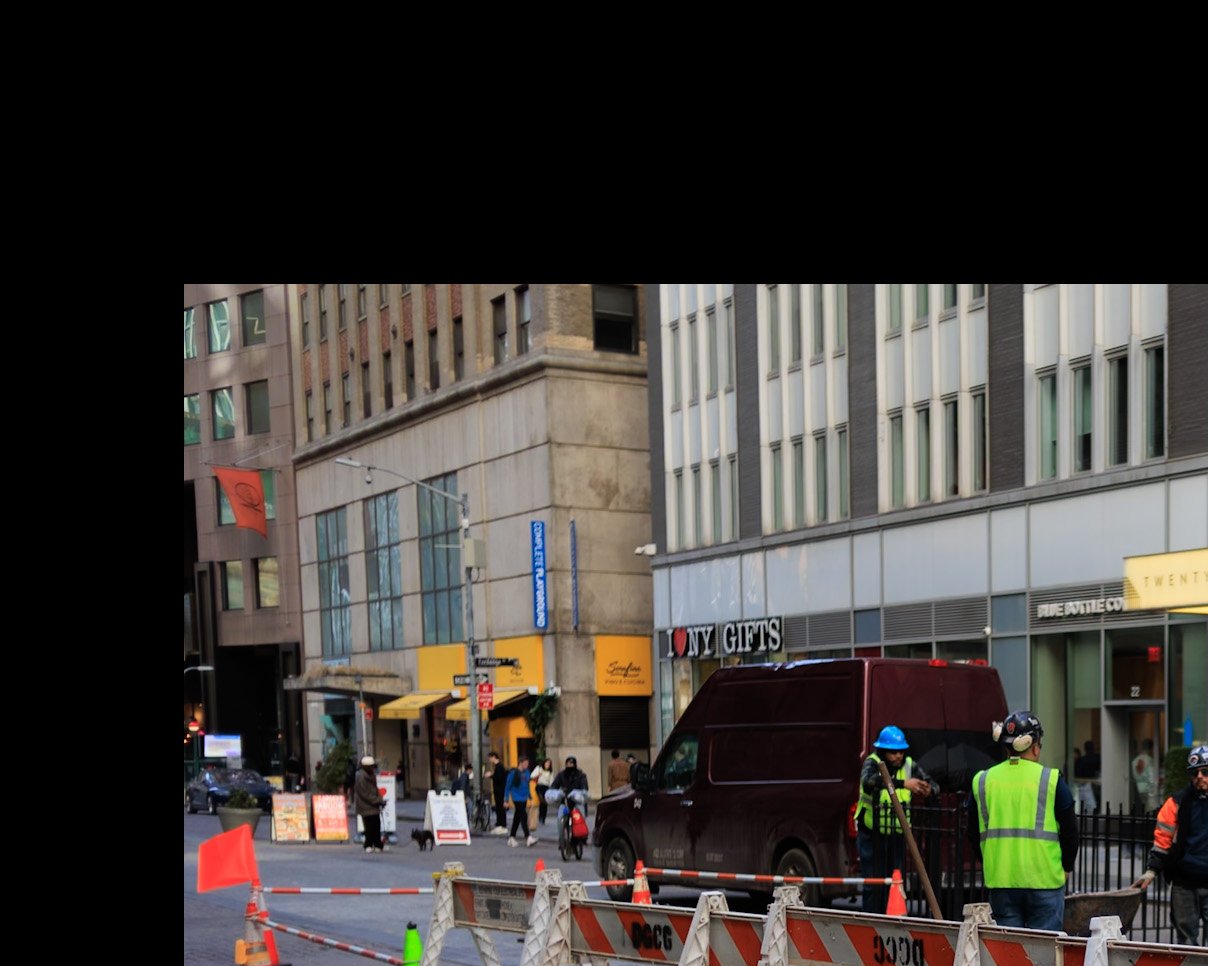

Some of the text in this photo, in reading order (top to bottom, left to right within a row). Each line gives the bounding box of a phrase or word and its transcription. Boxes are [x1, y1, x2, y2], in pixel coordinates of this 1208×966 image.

[533, 521, 546, 628] COMPLETE PLAYGROUND
[1037, 597, 1125, 618] BLUE BOTTLE CO
[666, 618, 781, 657] I NY GIFTS
